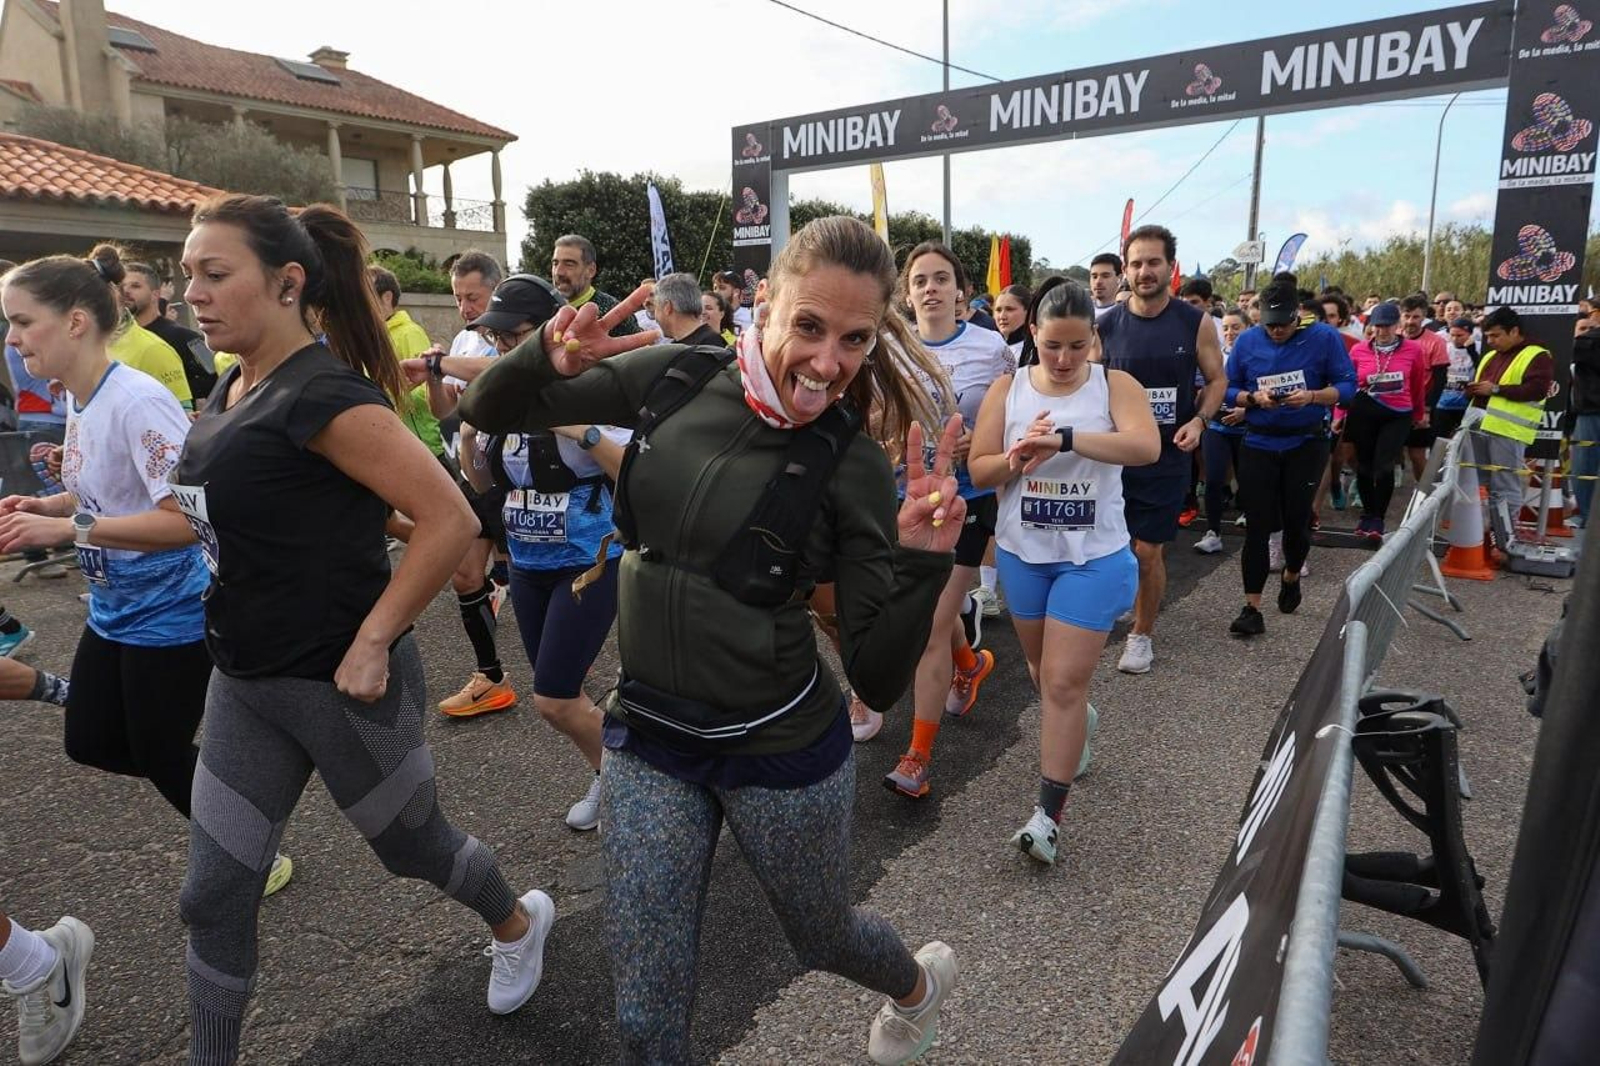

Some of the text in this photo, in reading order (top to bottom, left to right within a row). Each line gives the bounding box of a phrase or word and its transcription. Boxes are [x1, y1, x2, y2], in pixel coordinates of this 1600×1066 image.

[1260, 17, 1485, 95] MINIBAY
[989, 69, 1150, 132] MINIBAY
[783, 110, 901, 159] MINIBAY
[1502, 152, 1596, 177] MINIBAY
[734, 224, 771, 239] MINIBAY
[1487, 284, 1580, 304] MINIBAY
[1028, 480, 1091, 496] MINIBAY
[509, 509, 557, 528] 10812
[1034, 500, 1086, 517] 11761
